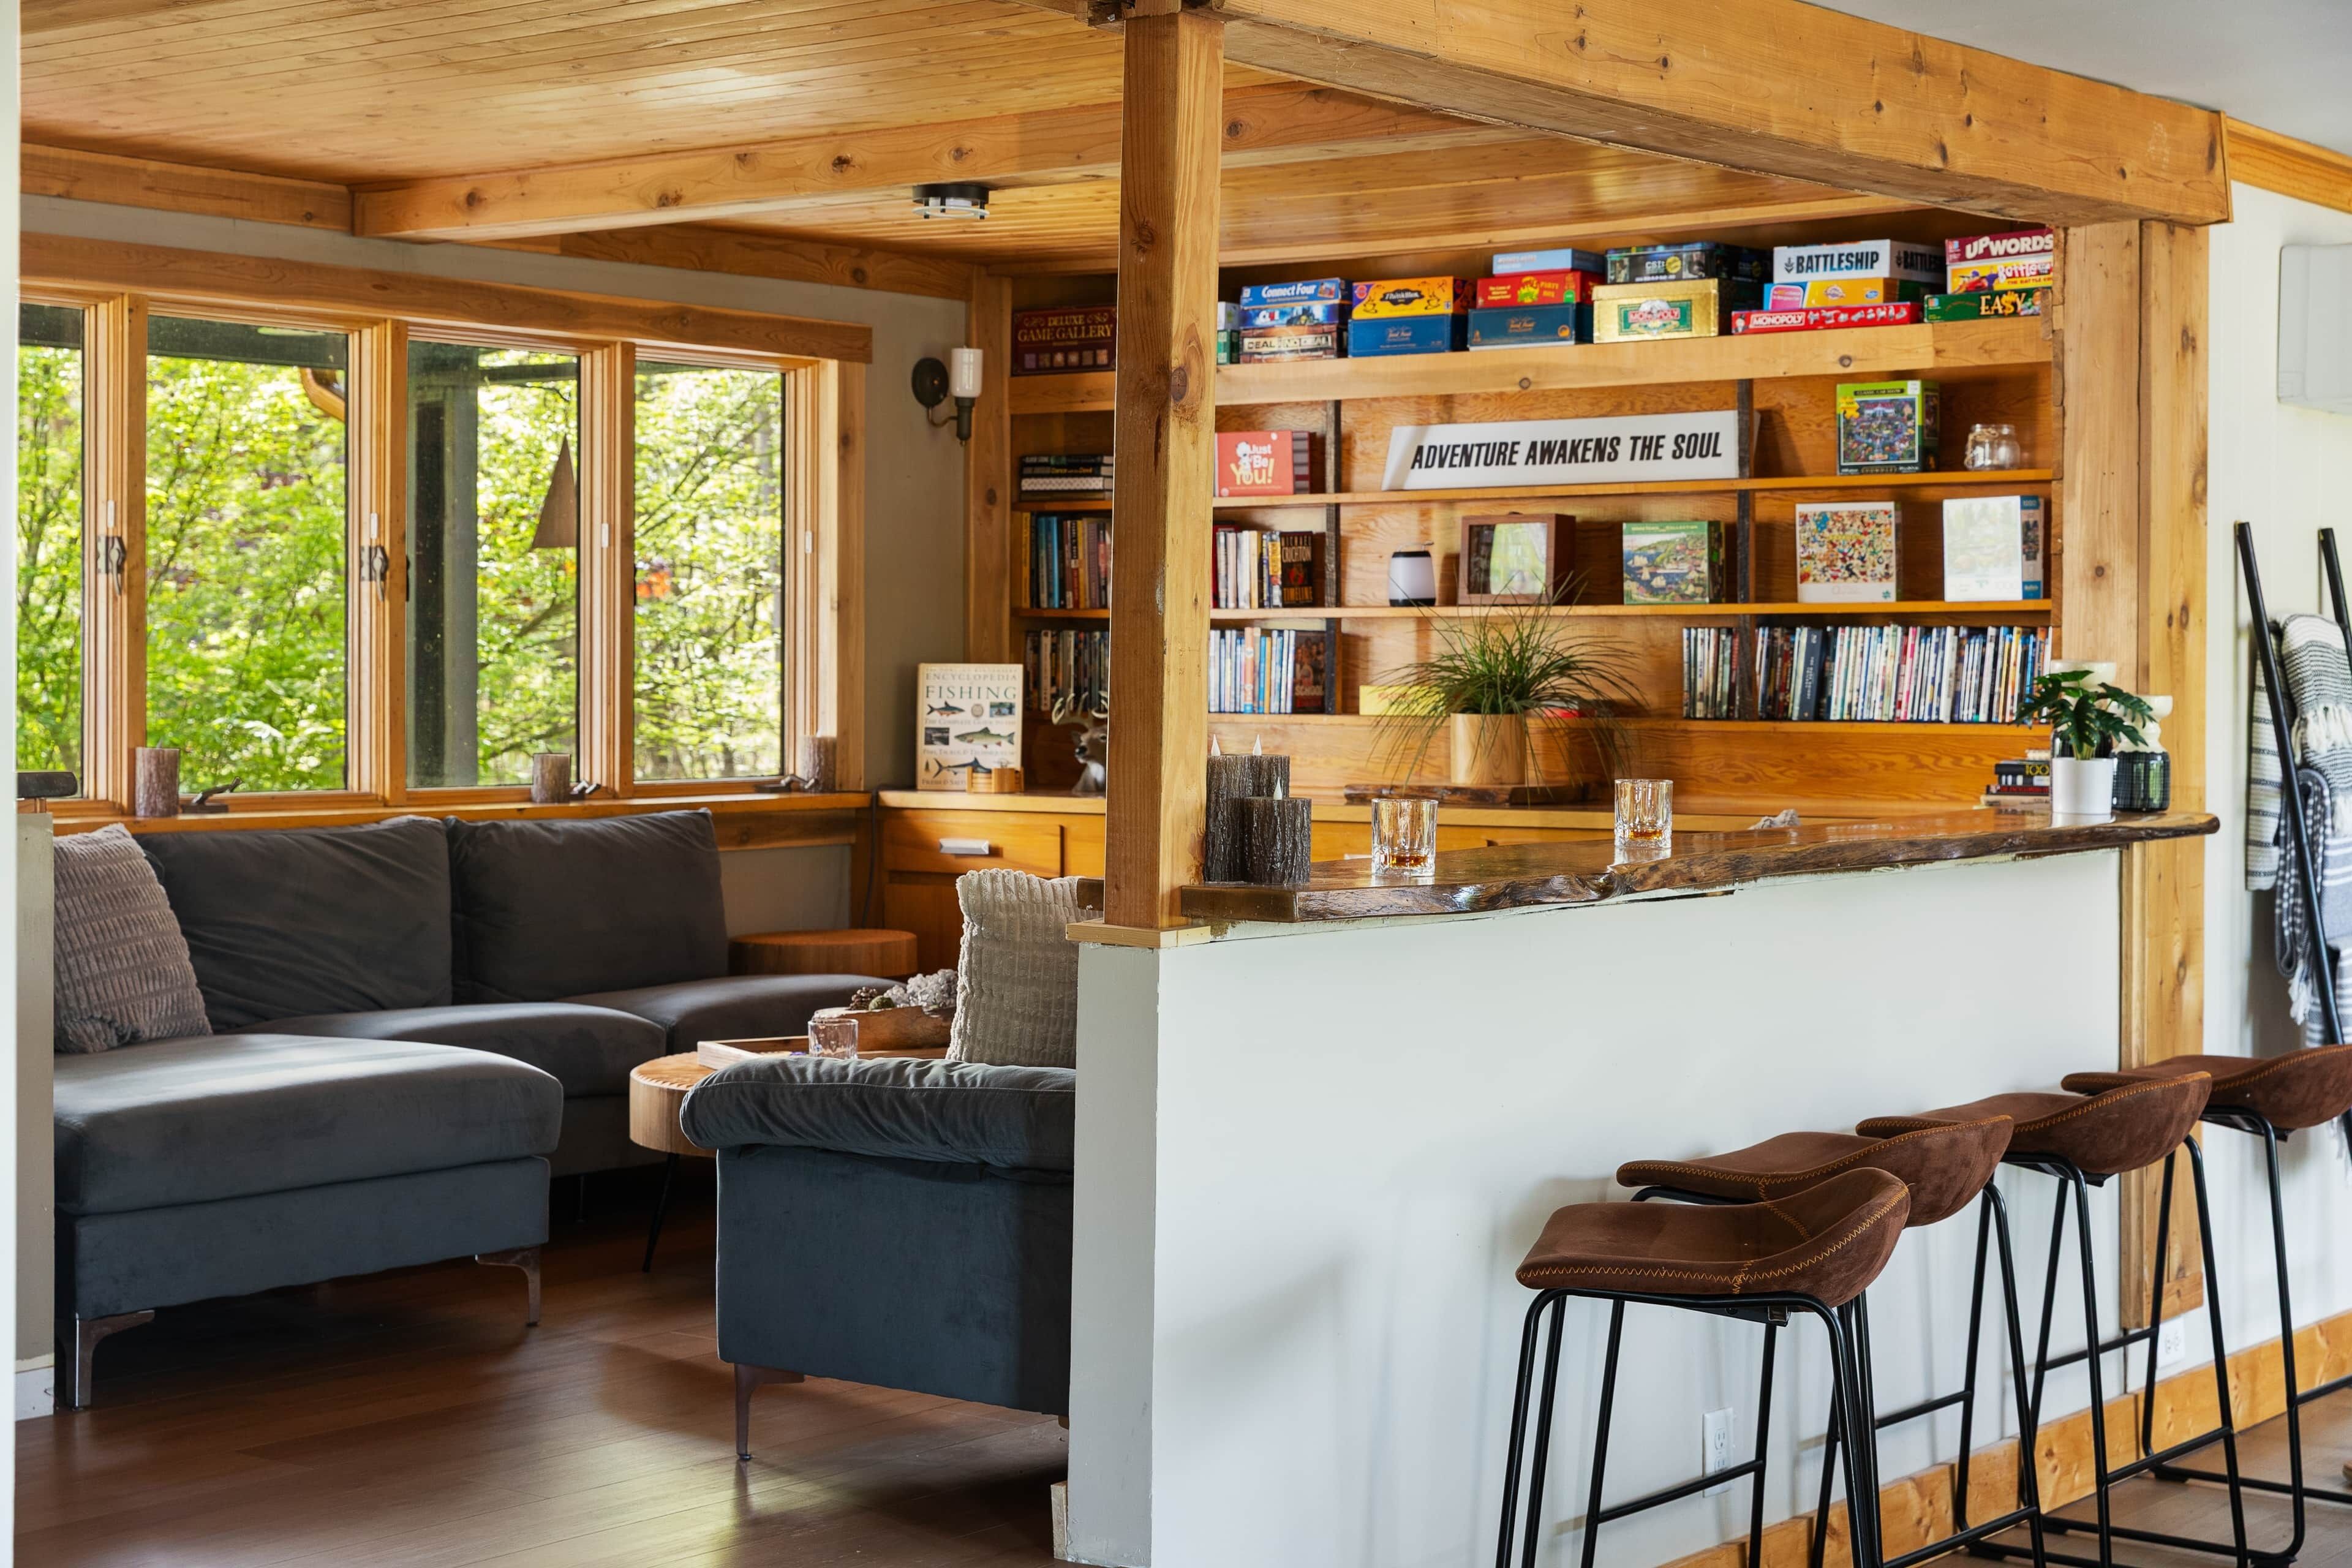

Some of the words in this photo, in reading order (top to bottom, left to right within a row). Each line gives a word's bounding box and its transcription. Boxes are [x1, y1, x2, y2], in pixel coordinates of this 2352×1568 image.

[1965, 234, 2053, 259] UPWORDS
[1796, 251, 1879, 273] BATTLESHIP
[1262, 285, 1295, 298] Connect
[1296, 283, 1316, 295] Four
[1048, 315, 1085, 326] DELUXE
[1753, 314, 1803, 326] MONOPOLY
[1018, 328, 1054, 342] GAME
[1056, 324, 1113, 339] GALLERY
[1247, 340, 1275, 349] DEAL
[1251, 444, 1272, 454] Just
[1411, 441, 1520, 470] ADVENTURE
[1525, 436, 1621, 466] AWAKENS
[1629, 435, 1665, 461] THE
[1672, 432, 1722, 459] SOUL
[1253, 454, 1268, 468] Be
[1229, 458, 1274, 485] You!
[926, 685, 1017, 699] FISHING
[2026, 764, 2049, 775] 100
